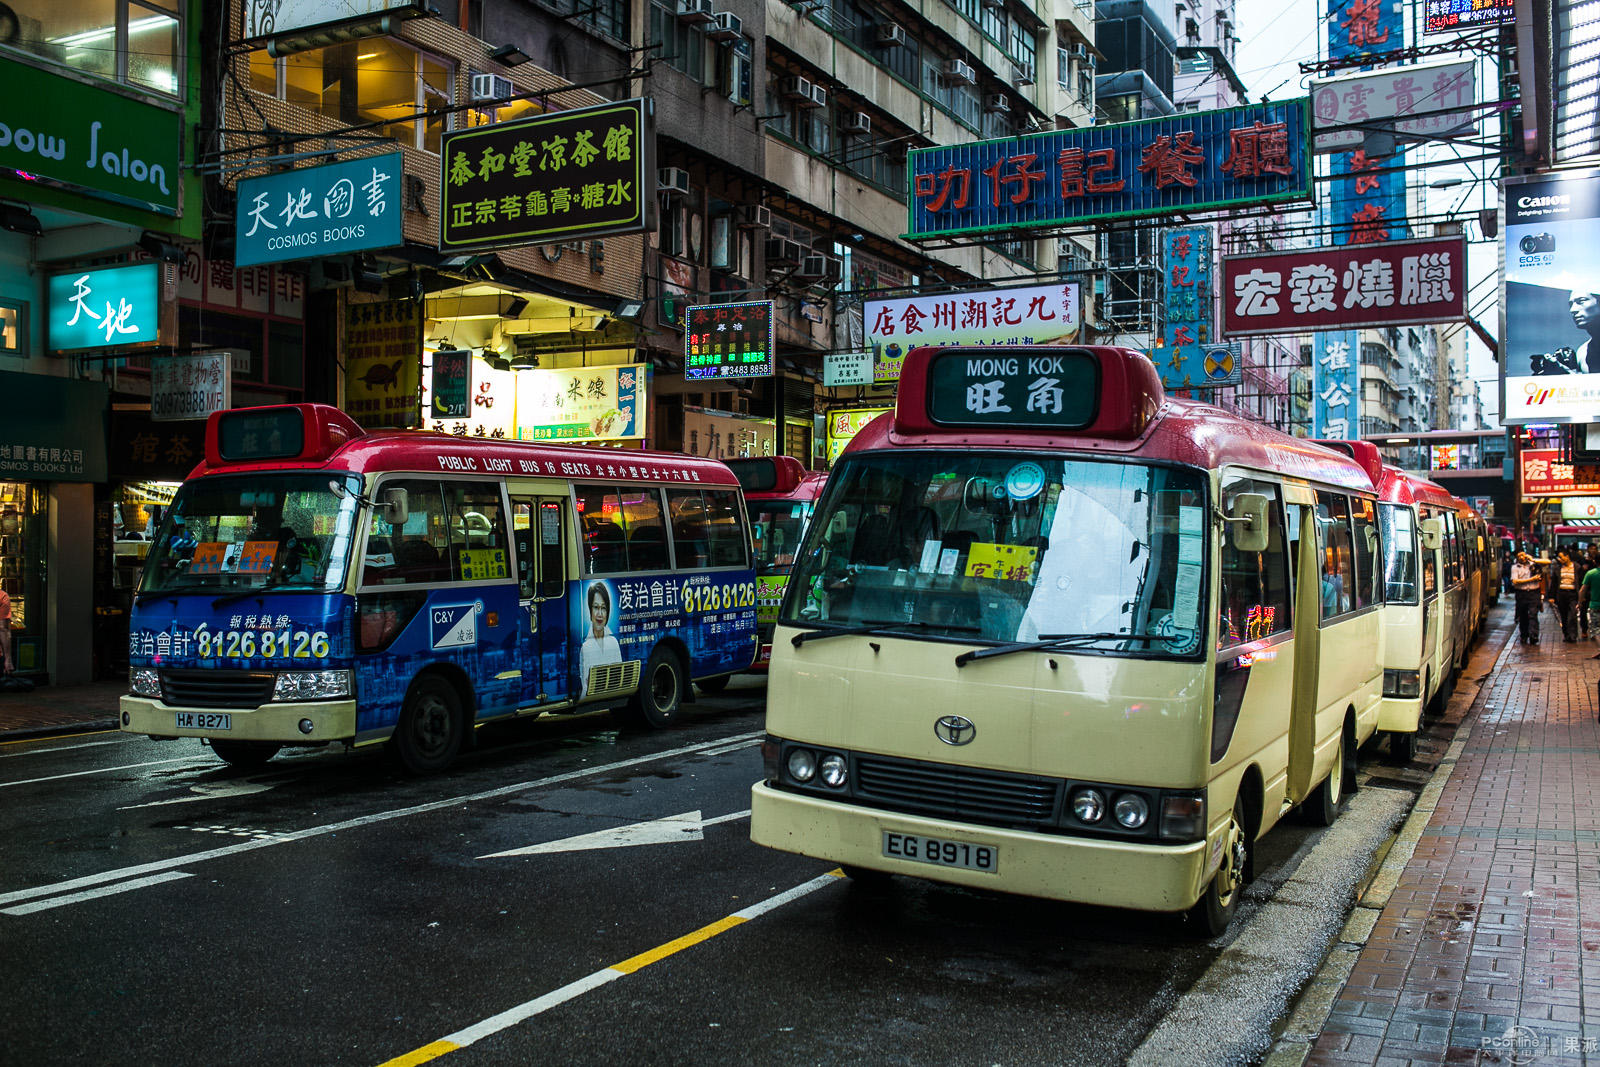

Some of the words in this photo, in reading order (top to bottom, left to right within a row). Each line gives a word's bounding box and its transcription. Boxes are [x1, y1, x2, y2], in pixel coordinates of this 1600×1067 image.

[86, 121, 170, 195] Salon
[449, 124, 633, 187] 泰和堂凉茶館
[915, 119, 1293, 213] 叻仔記餐廳
[244, 166, 391, 237] 天地圖書
[1517, 195, 1570, 208] Canon
[267, 231, 318, 251] COSMOS
[323, 223, 365, 244] BOOKS
[1519, 255, 1541, 264] EOS
[1234, 251, 1455, 318] 宏發燒臘
[66, 273, 139, 342] 天地
[730, 366, 748, 374] 3483
[966, 359, 1020, 377] MONG
[1027, 356, 1066, 374] KOK
[965, 377, 1066, 415] 旺角
[447, 404, 465, 416] 2/F
[32, 463, 66, 473] BOOKS
[437, 456, 478, 471] PUBLIC
[481, 459, 513, 473] LIGHT
[518, 460, 540, 473] BUS
[544, 461, 556, 474] 16
[561, 463, 592, 476] SEATS
[617, 579, 679, 610] 凌治會計
[684, 585, 719, 613] 8126
[722, 582, 755, 609] 8126
[434, 611, 454, 624] C&Y
[198, 632, 255, 657] 8126
[260, 632, 330, 658] 8126
[177, 714, 193, 727] HA
[197, 714, 230, 729] 8271
[887, 836, 917, 856] EG
[926, 840, 991, 868] 8918
